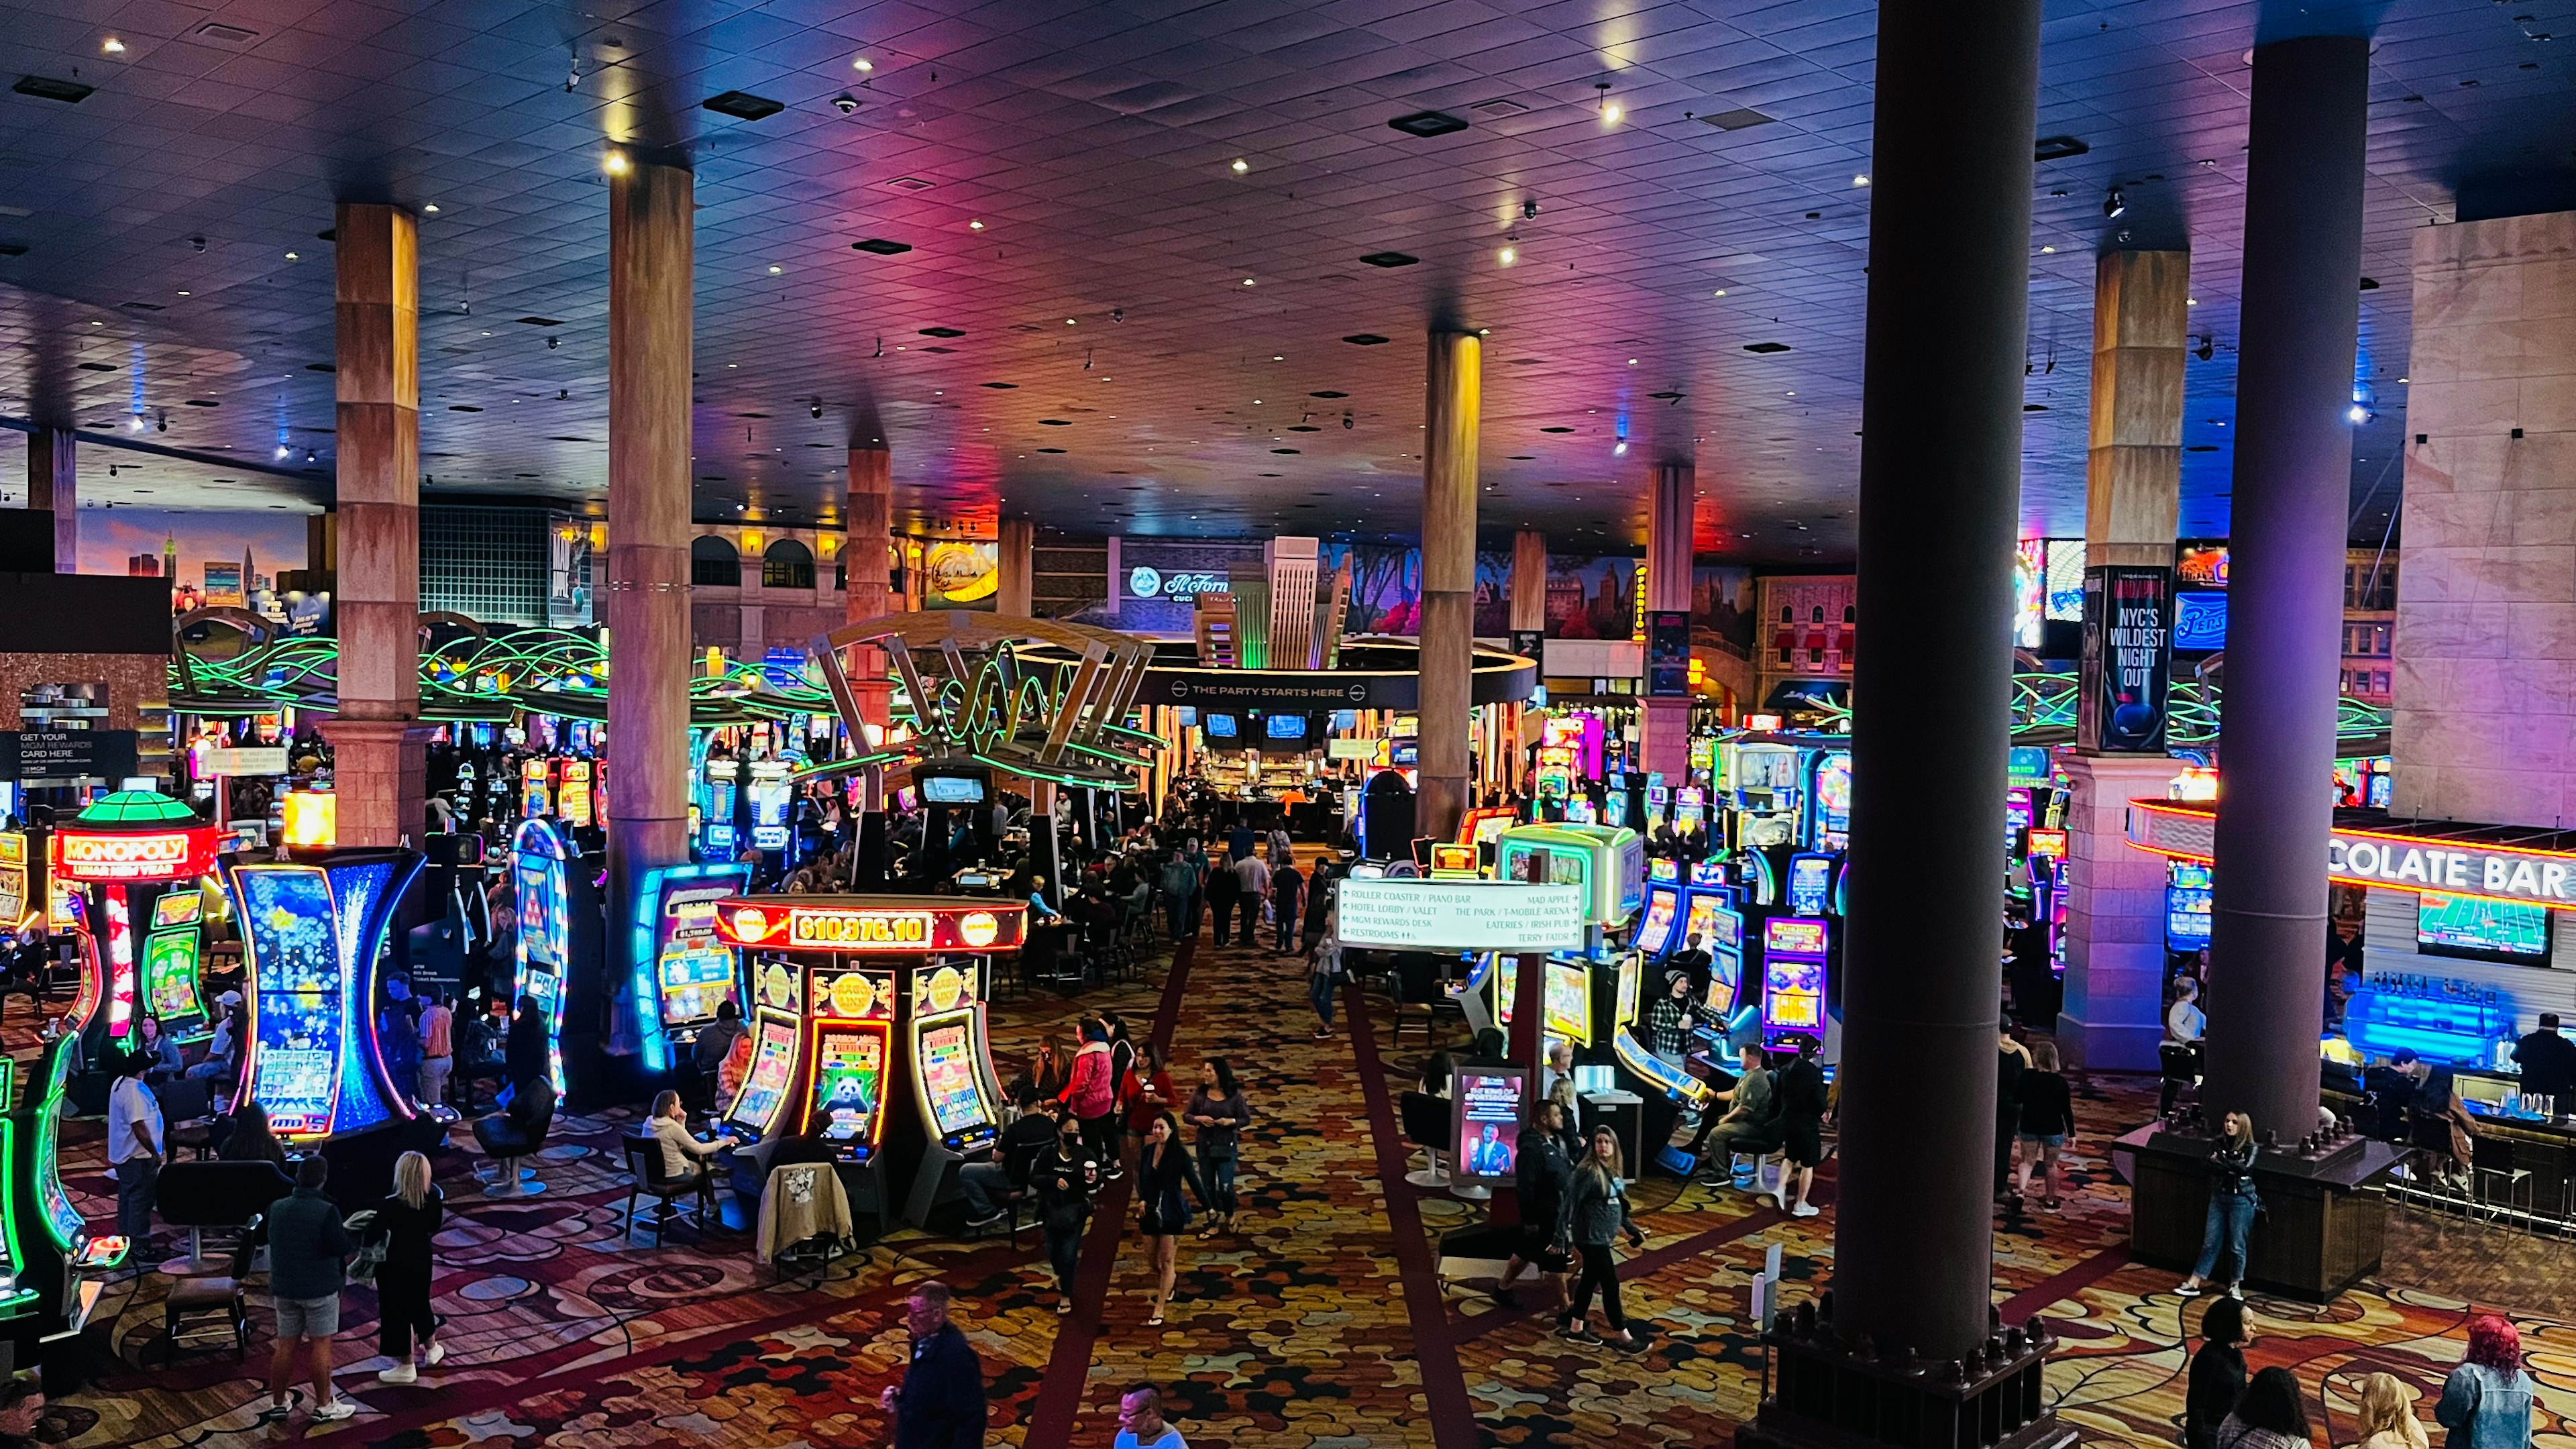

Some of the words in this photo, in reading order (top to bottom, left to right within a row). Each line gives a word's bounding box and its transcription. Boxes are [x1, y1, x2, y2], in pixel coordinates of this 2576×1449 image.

[1164, 574, 1192, 594] Il
[2119, 608, 2159, 627] NYC'S
[2110, 628, 2167, 647] WILDEST
[2117, 648, 2157, 667] NIGHT
[2123, 668, 2151, 687] OUT
[1193, 686, 1217, 694] THE
[1220, 686, 1259, 696] PARTY
[1261, 688, 1309, 697] STARTS
[1311, 688, 1344, 697] HERE
[47, 741, 93, 749] REWARDS
[21, 750, 47, 758] CARD
[49, 749, 74, 757] HERE
[67, 840, 183, 862] MONOPOLY
[140, 863, 174, 876] YEAR
[2483, 856, 2566, 898] BAR
[1351, 890, 1381, 900] ROLLER
[1384, 892, 1420, 902] COASTER
[1429, 894, 1453, 903] PIANO
[1455, 895, 1471, 903] BAR
[1527, 896, 1546, 904] MAD
[1547, 896, 1570, 904] APPLE
[1351, 903, 1376, 912] HOTEL
[1379, 905, 1405, 914] LOBBY
[1413, 907, 1437, 915] VALET
[1455, 908, 1471, 916] THE
[1474, 908, 1496, 916] PARK
[1504, 908, 1542, 916] T-MOBILE
[1544, 907, 1570, 915] ARENA
[1351, 916, 1371, 925] MGM
[1373, 917, 1409, 926] REWARDS
[1412, 919, 1433, 928] DESK
[1486, 920, 1523, 929] EATERIES
[1531, 920, 1552, 928] IRISH
[1554, 920, 1570, 928] PUB
[799, 916, 922, 942] $10,376.10
[1350, 928, 1399, 939] RESTROOMS
[1518, 934, 1543, 943] TERRY
[1546, 932, 1569, 941] FATOR
[830, 983, 875, 996] DRAGON
[839, 996, 865, 1007] LINK
